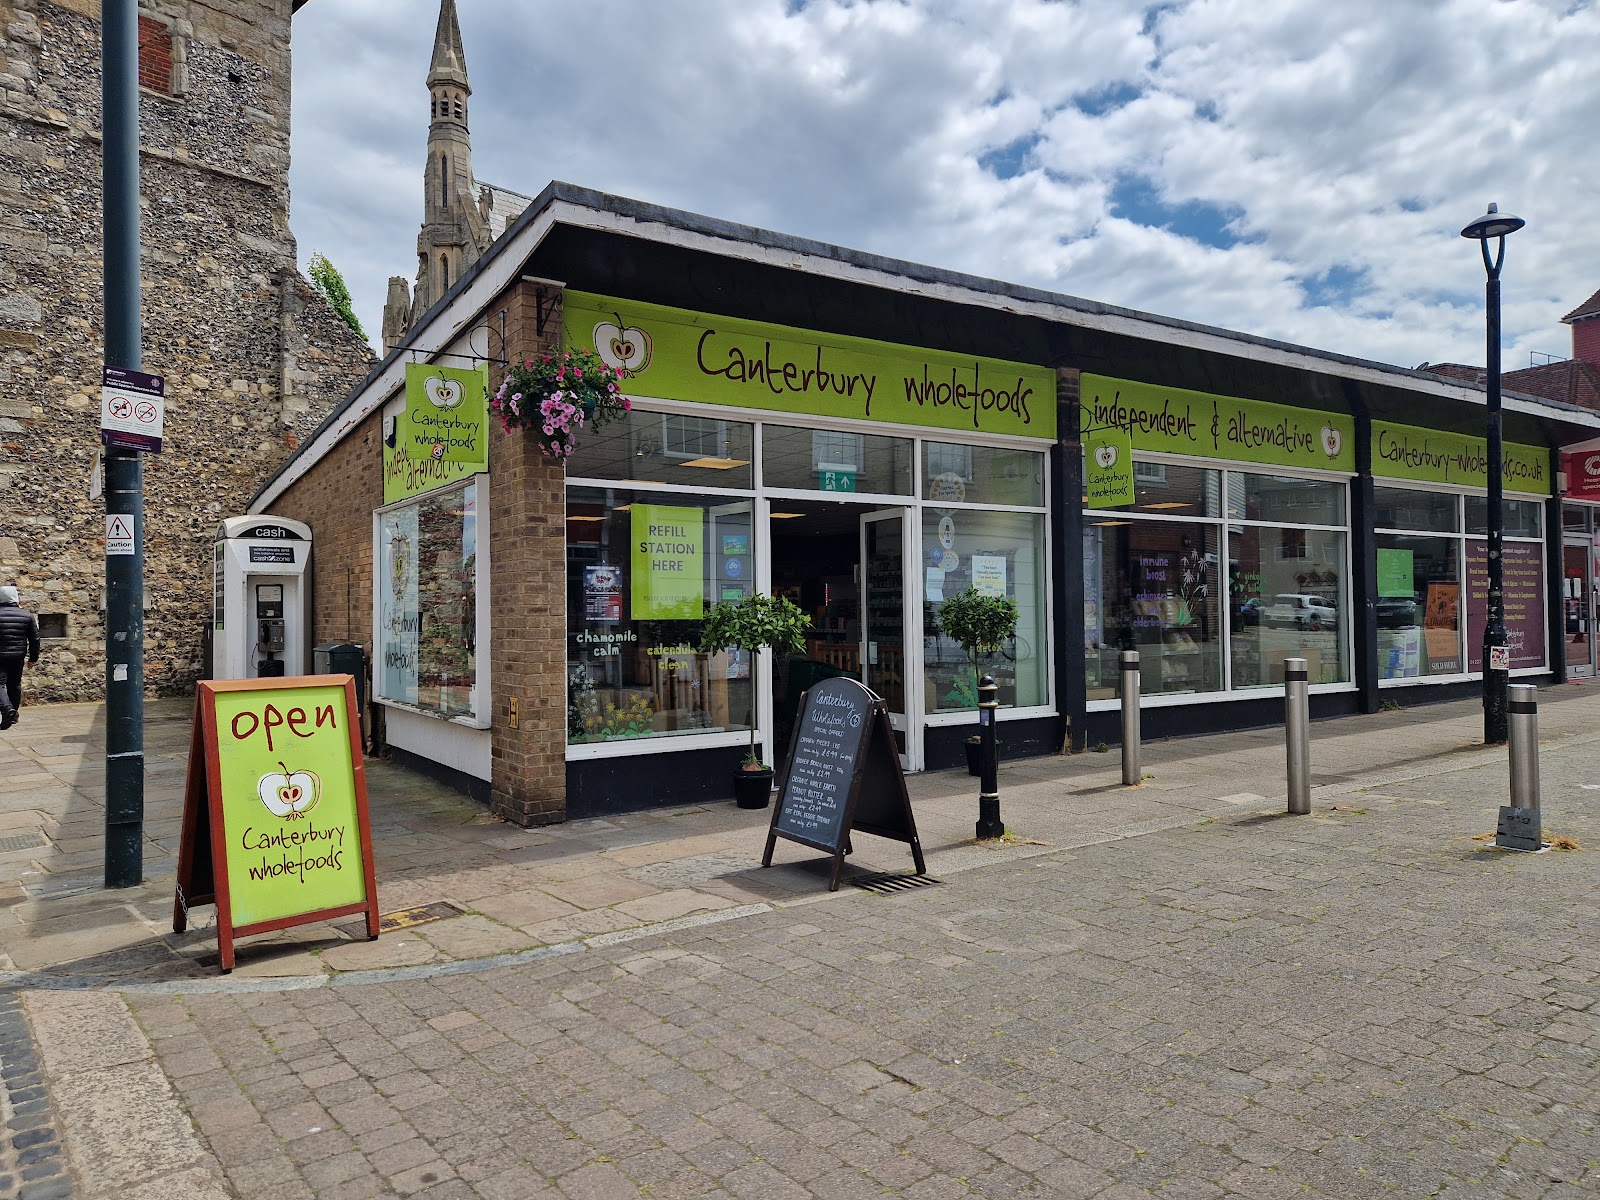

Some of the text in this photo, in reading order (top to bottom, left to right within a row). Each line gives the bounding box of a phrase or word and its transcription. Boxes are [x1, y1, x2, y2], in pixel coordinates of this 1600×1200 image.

[697, 329, 1033, 427] Canterbury wholefoods
[412, 408, 479, 435] Canterbury
[1094, 390, 1315, 453] independent & alternative
[414, 428, 476, 454] wholefoods
[1379, 429, 1543, 481] Canterbury-wholeds.co.uk
[1089, 472, 1129, 488] Canterbury
[1091, 482, 1128, 501] wholefoods
[255, 527, 286, 538] cash
[649, 525, 686, 538] REFILL
[640, 542, 695, 555] STATION
[652, 560, 684, 571] HERE
[1140, 555, 1169, 567] immune
[1146, 568, 1167, 581] boost
[576, 629, 638, 643] chamomile
[593, 644, 620, 657] calm
[646, 642, 698, 656] calendula
[976, 641, 1004, 653] detox
[658, 658, 689, 670] clean
[815, 690, 857, 719] Canterbury
[811, 708, 846, 728] Wholefoods
[231, 703, 336, 752] open
[242, 822, 345, 851] Canterbury
[249, 844, 344, 884] wholefoods
